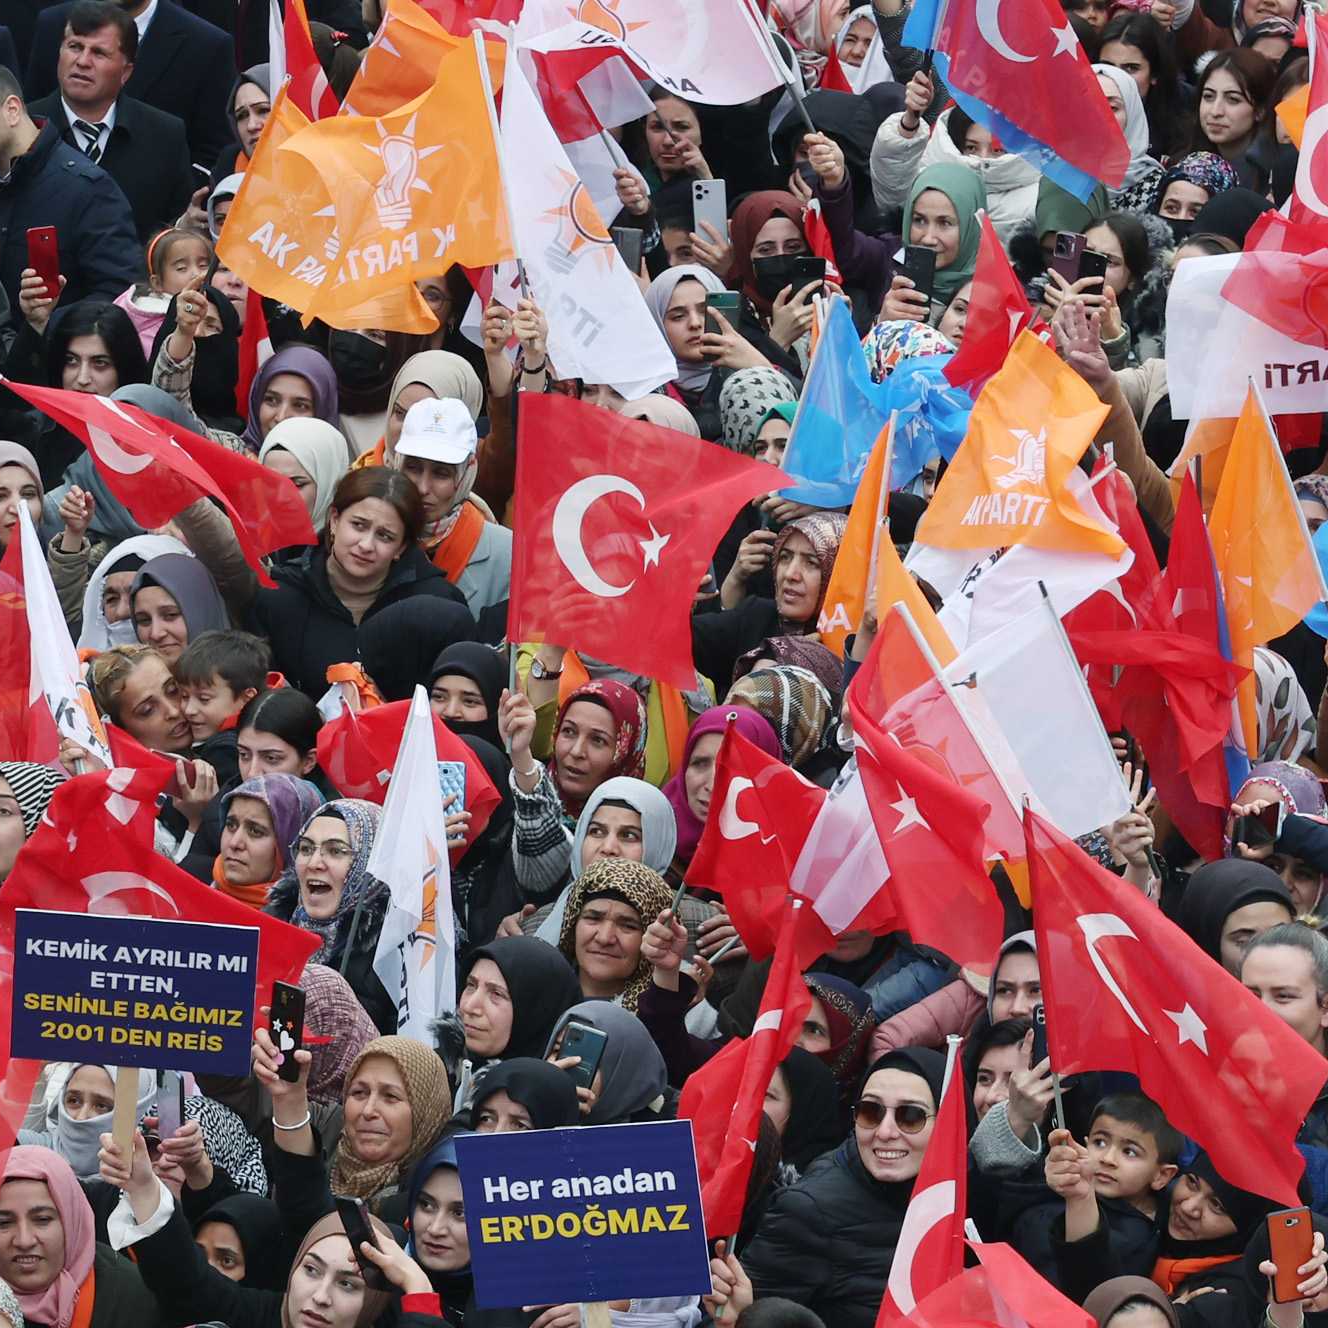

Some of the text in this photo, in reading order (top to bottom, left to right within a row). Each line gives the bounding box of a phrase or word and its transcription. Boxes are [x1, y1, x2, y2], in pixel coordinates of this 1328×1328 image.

[248, 222, 299, 267] AK
[25, 937, 246, 973] KEMİK AYRILIR MI
[89, 970, 179, 998] ETTEN,
[23, 991, 241, 1027] SENİNLE BAĞIMIZ
[40, 1020, 223, 1052] 2001 DEN REİS
[483, 1167, 677, 1204] Her anadan
[480, 1203, 690, 1244] ER'DOĞMAZ
